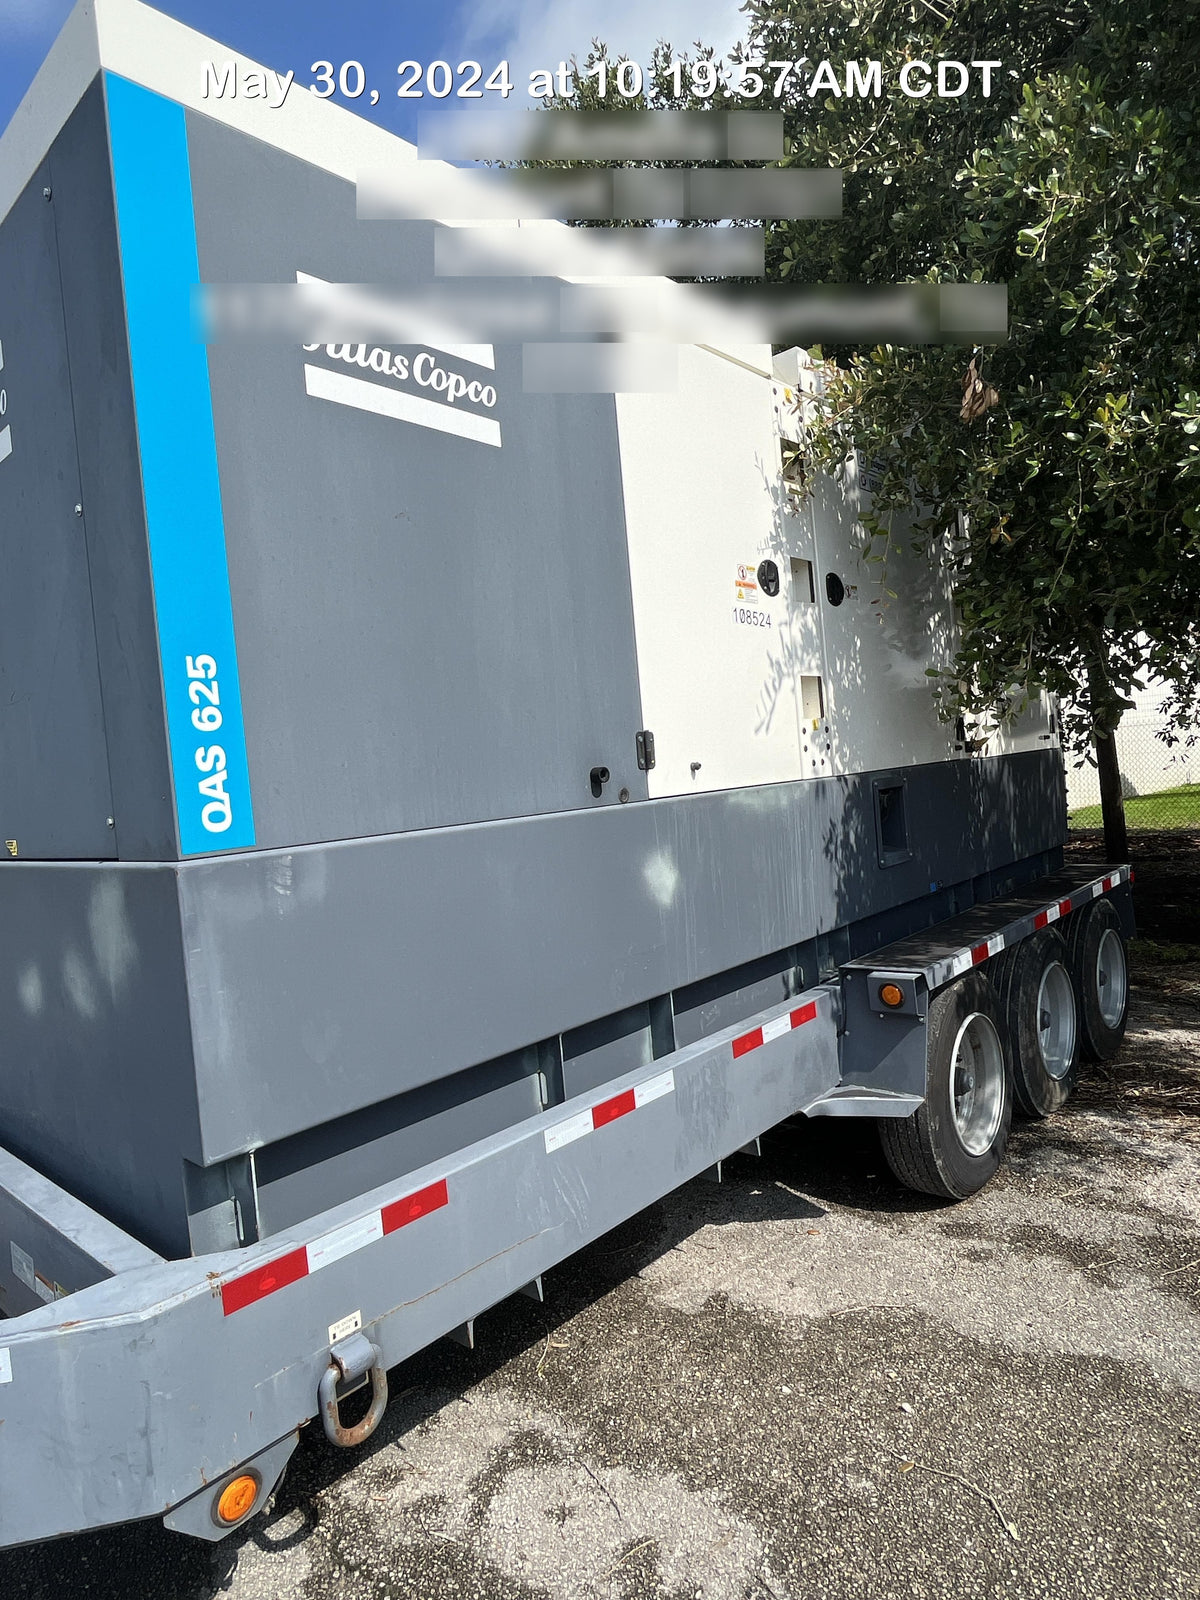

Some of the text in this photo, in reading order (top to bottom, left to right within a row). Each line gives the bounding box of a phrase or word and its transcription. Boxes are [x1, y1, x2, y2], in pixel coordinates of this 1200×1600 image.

[413, 352, 497, 408] Copco
[733, 607, 772, 629] 108524
[185, 653, 233, 834] QAS 625
